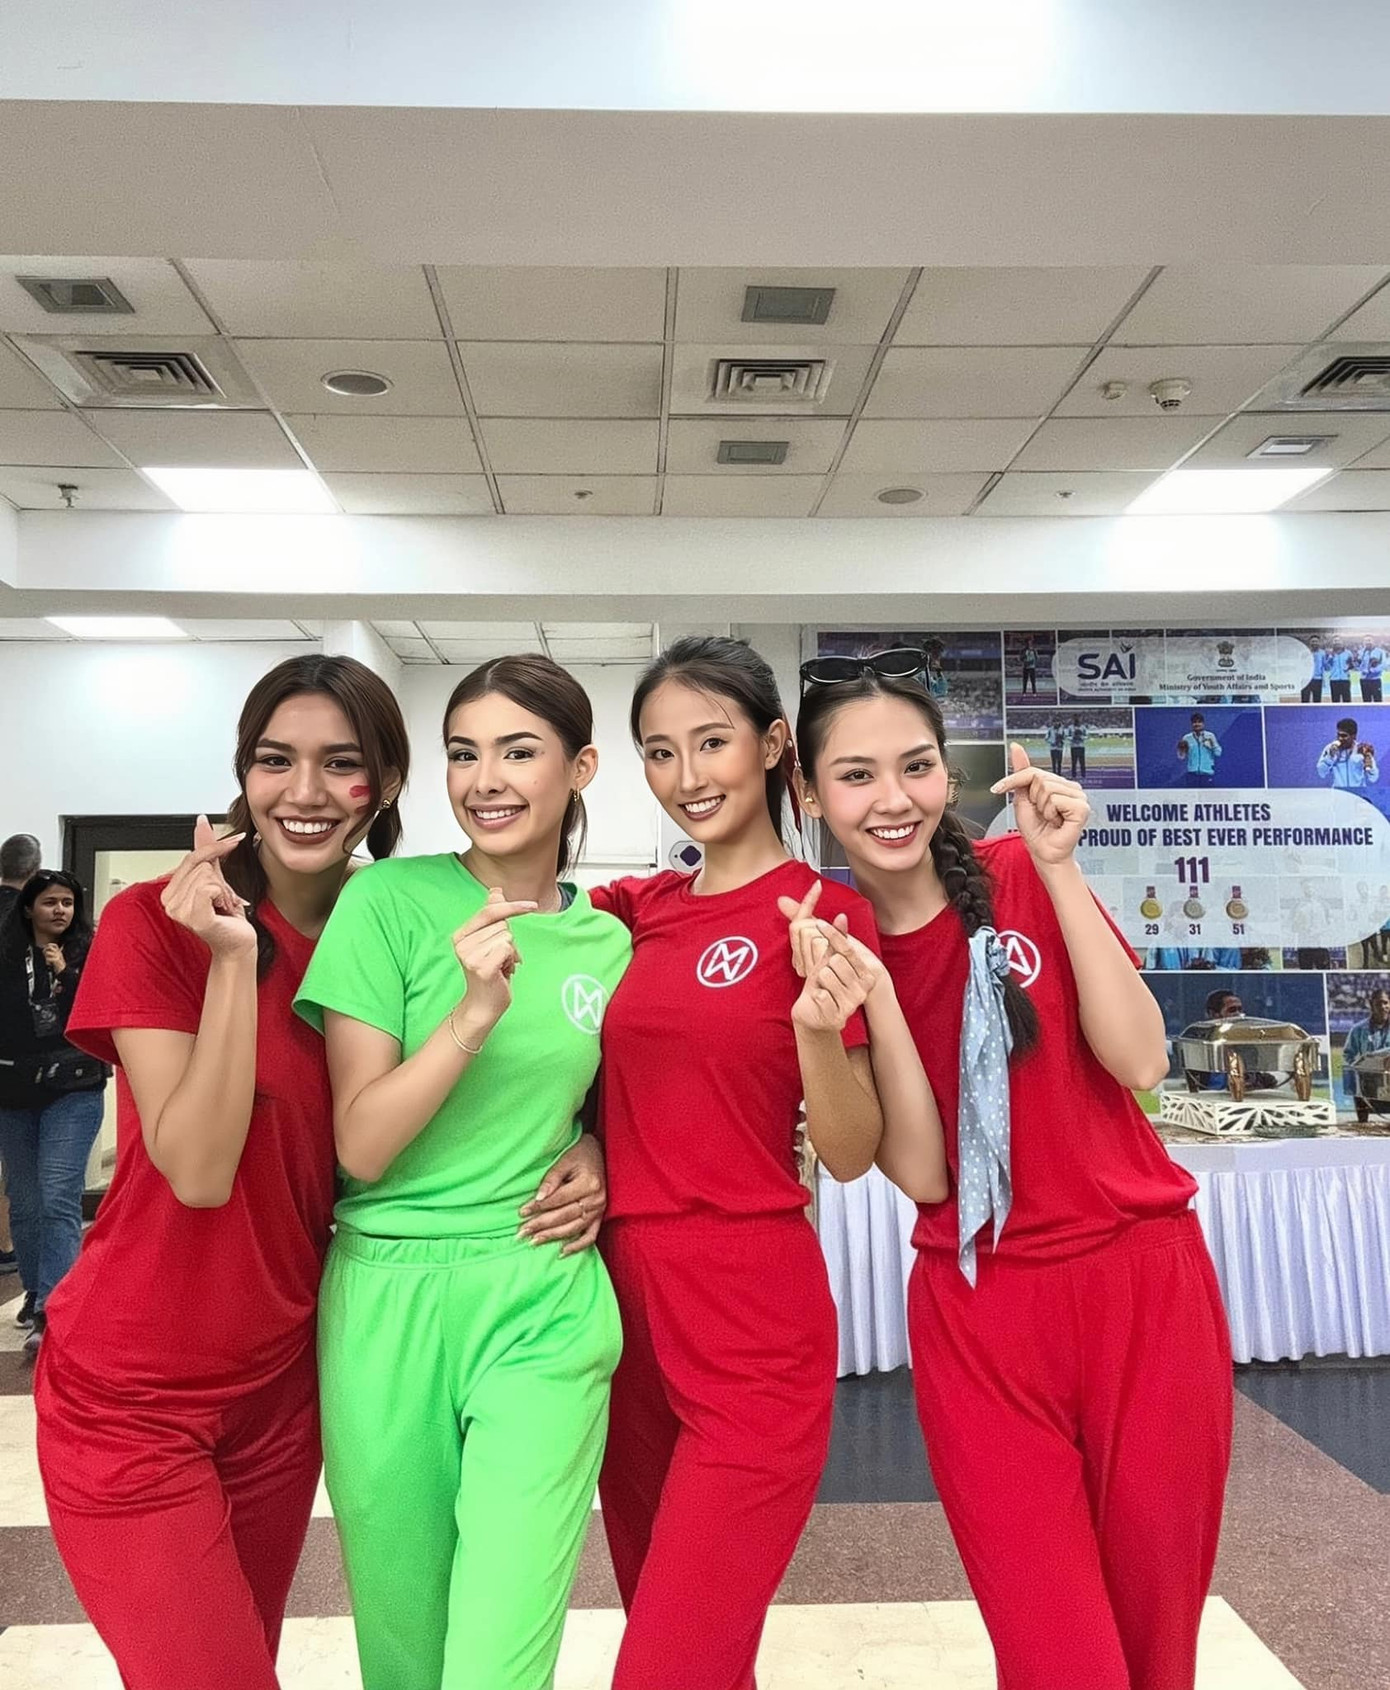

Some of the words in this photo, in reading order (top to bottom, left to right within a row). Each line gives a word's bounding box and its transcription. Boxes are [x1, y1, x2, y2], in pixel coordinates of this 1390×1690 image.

[1077, 653, 1136, 680] SAI
[1186, 673, 1235, 681] Government
[1236, 673, 1245, 681] of
[1245, 673, 1266, 681] India
[1159, 683, 1192, 692] Ministry
[1193, 683, 1202, 691] of
[1203, 683, 1225, 691] Youth
[1226, 683, 1253, 691] Affairs
[1253, 683, 1269, 691] and
[1270, 683, 1296, 691] Sports
[1106, 803, 1189, 822] WELCOME
[1193, 803, 1271, 822] ATHLETES
[1078, 828, 1132, 847] PROUD
[1137, 828, 1157, 846] OF
[1162, 828, 1202, 846] BEST
[1207, 828, 1247, 846] EVER
[1252, 827, 1373, 846] PERFORMANCE
[1174, 856, 1210, 884] 111
[1145, 923, 1159, 935] 29
[1189, 923, 1201, 935] 31
[1232, 923, 1245, 935] 51
